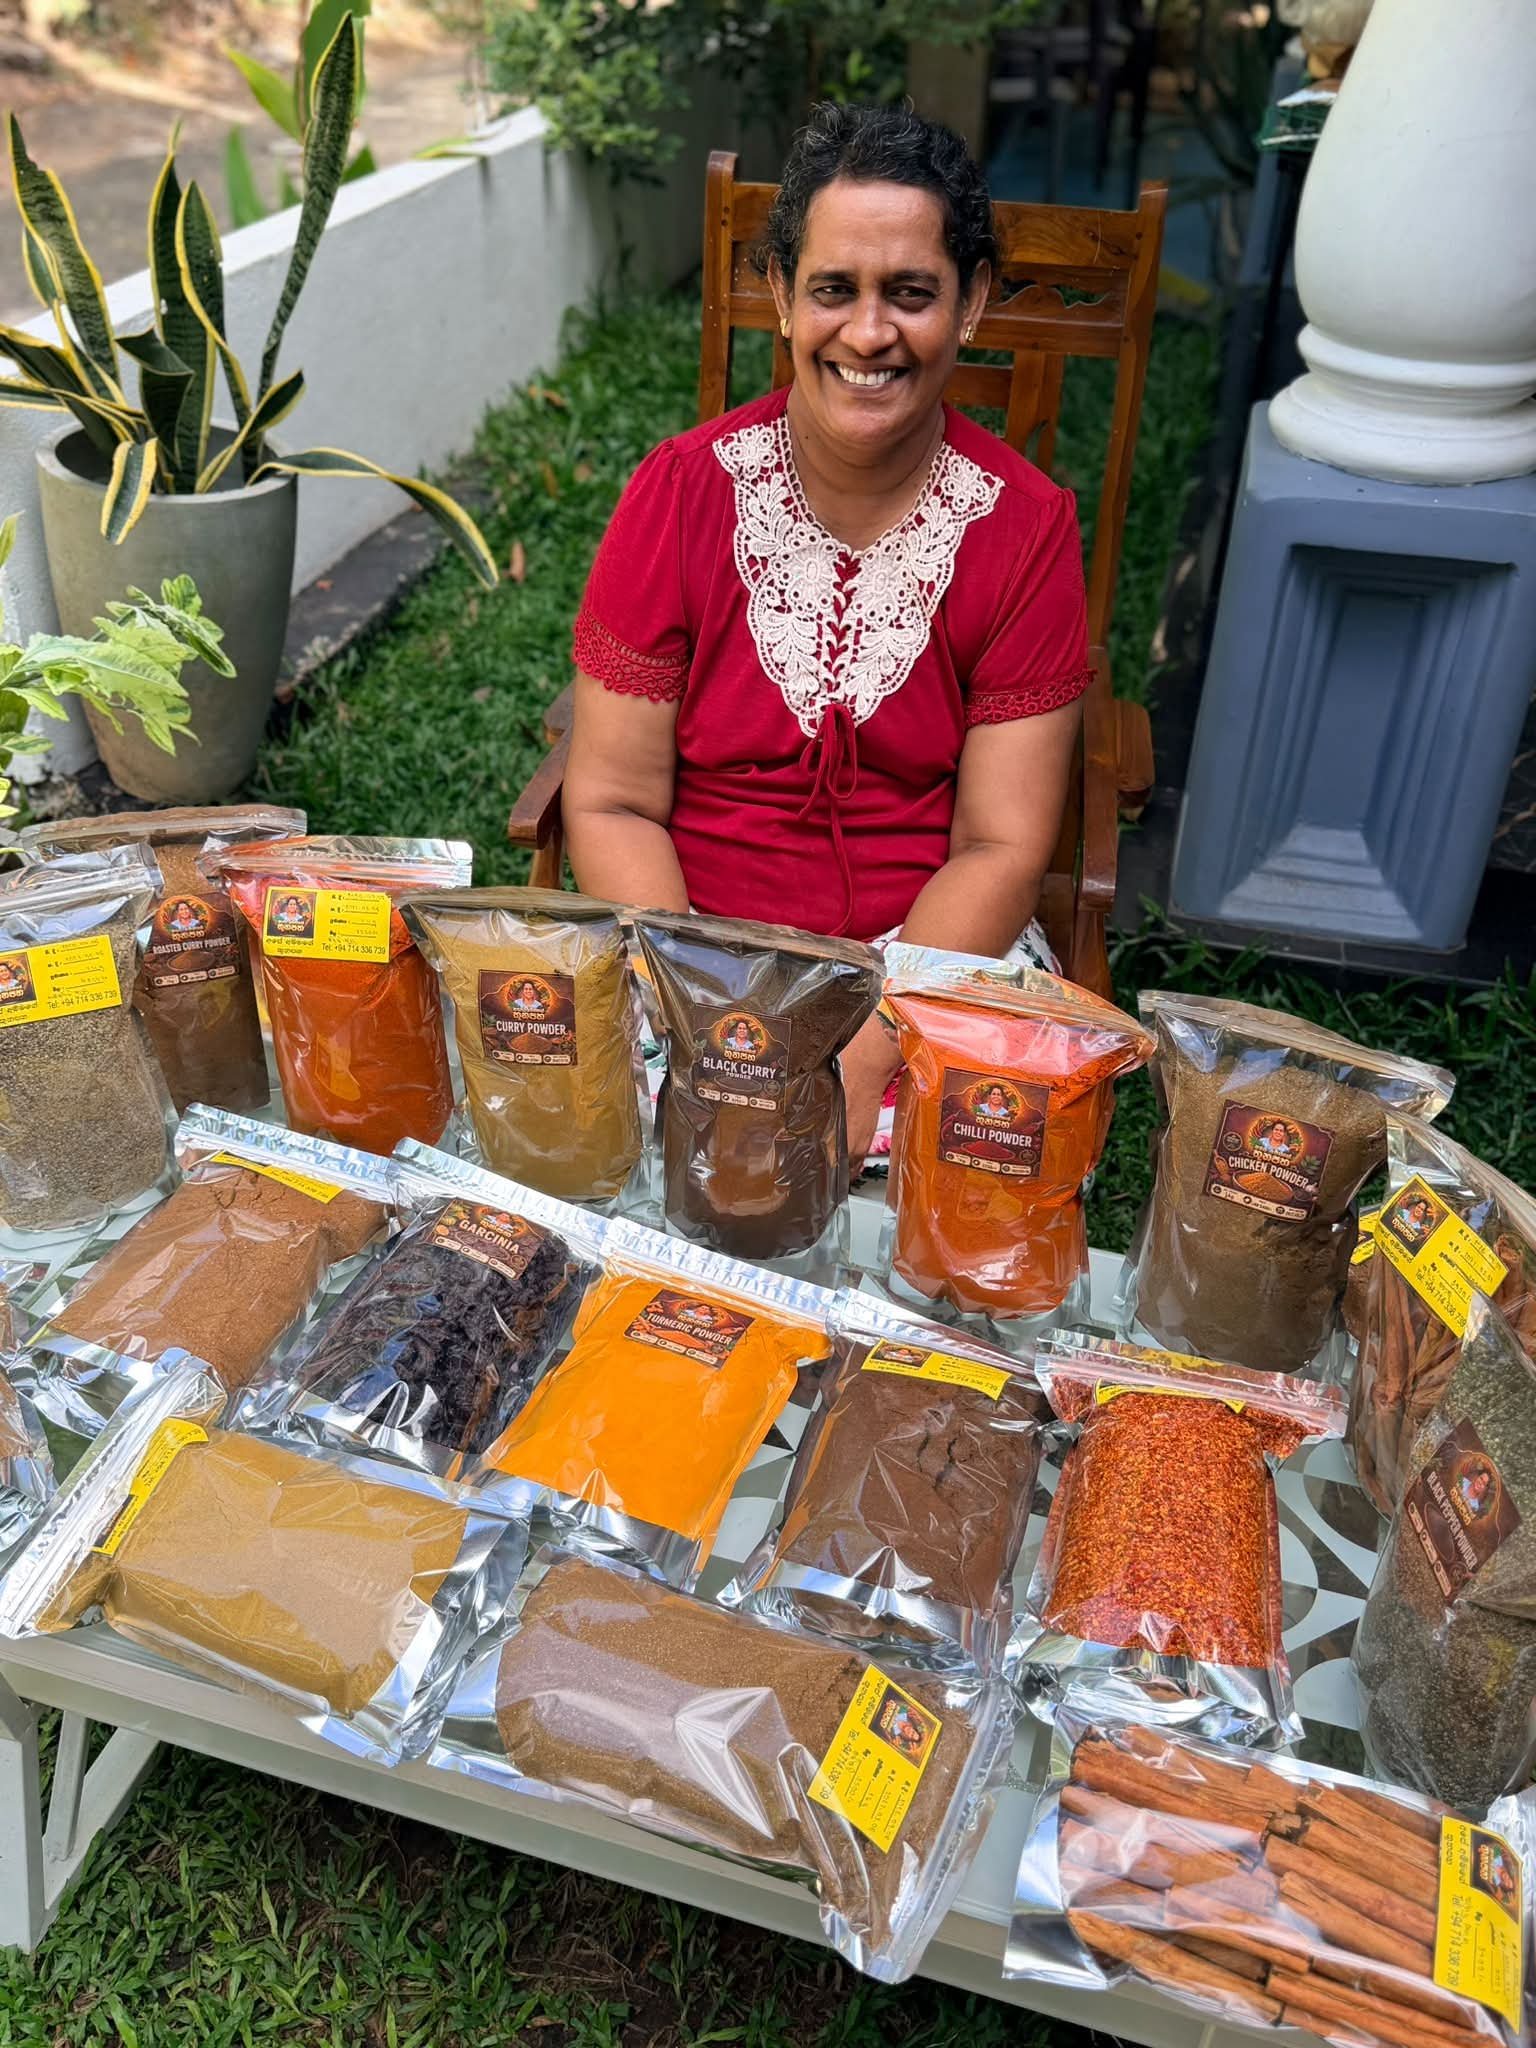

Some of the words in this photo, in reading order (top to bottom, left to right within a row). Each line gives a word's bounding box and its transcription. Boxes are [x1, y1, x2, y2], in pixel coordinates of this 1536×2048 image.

[152, 943, 181, 954] ROASTED
[182, 940, 203, 951] CURRY
[204, 937, 231, 948] POWDER
[348, 945, 359, 953] 714
[374, 946, 386, 954] 739
[76, 996, 88, 1004] 714
[104, 990, 117, 999] 739
[496, 1020, 525, 1033] CURRY
[527, 1023, 567, 1035] POWDER
[703, 1056, 737, 1073] BLACK
[741, 1063, 776, 1079] CURRY
[726, 1071, 752, 1080] POWDER
[954, 1122, 986, 1139] CHILLI
[989, 1130, 1032, 1147] POWDER
[1228, 1156, 1267, 1172] CHICKEN
[1270, 1164, 1309, 1188] POWDER
[459, 1219, 520, 1254] GARCINIA
[645, 1313, 692, 1333] TURMERIC
[693, 1325, 732, 1345] POWDER
[1426, 1470, 1445, 1503] BLACK
[1440, 1497, 1462, 1534] PEPPER
[1455, 1526, 1479, 1570] POWDER
[842, 1742, 852, 1757] +94
[833, 1754, 846, 1772] 714
[827, 1768, 839, 1785] 336
[819, 1783, 832, 1800] 739
[1449, 1929, 1461, 1947] 714
[1446, 1968, 1461, 1987] 739
